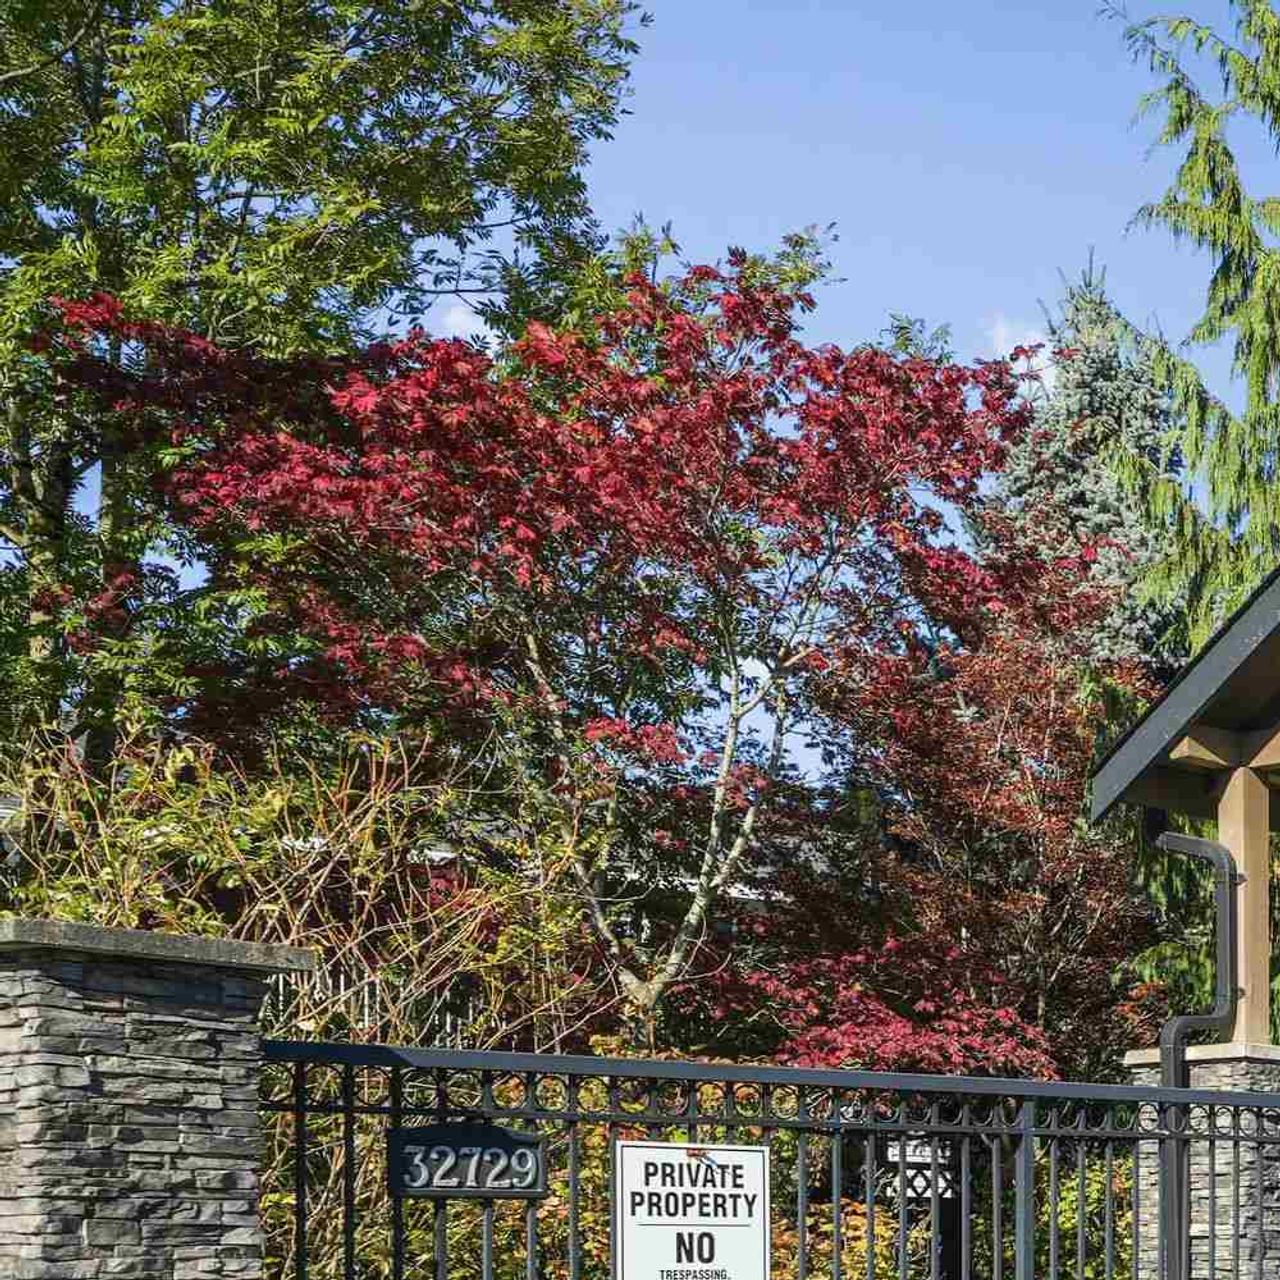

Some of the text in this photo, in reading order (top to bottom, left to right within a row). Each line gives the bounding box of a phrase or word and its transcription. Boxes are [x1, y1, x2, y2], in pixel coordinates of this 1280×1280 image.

[403, 1145, 537, 1188] 32729
[644, 1162, 744, 1188] PRIVATE
[630, 1191, 757, 1218] PROPERTY
[676, 1232, 715, 1264] NO
